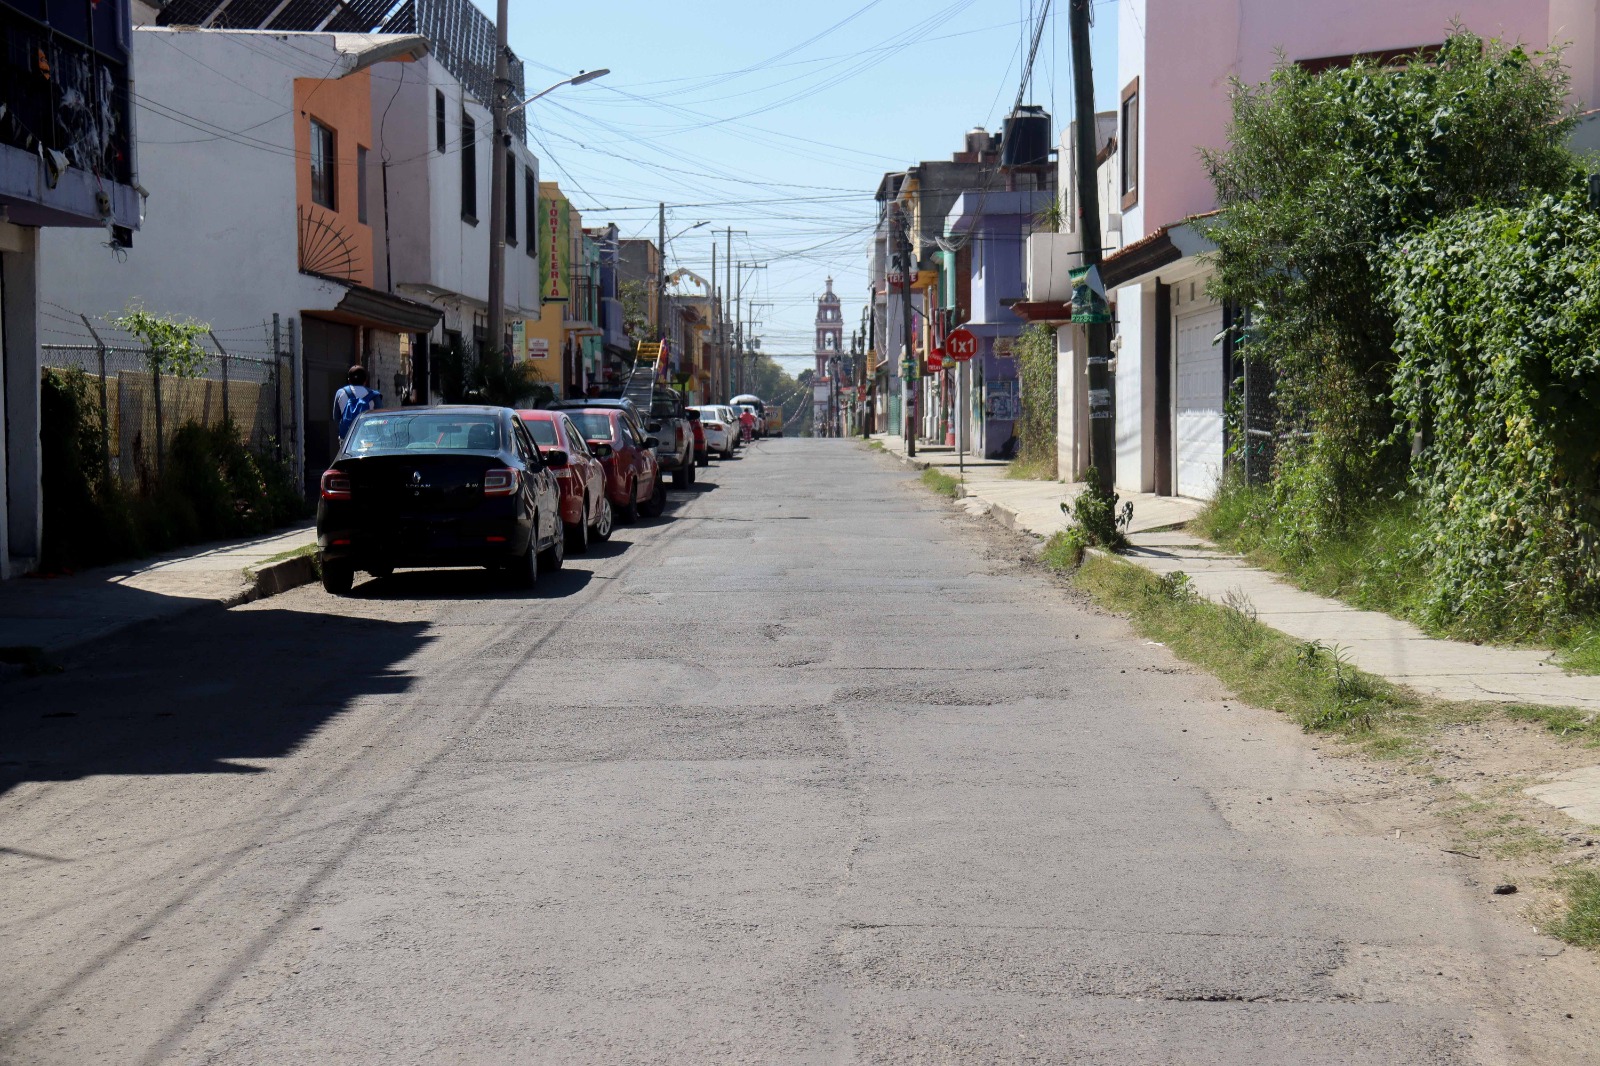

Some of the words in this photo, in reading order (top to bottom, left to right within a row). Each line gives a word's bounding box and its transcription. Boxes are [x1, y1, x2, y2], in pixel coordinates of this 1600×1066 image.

[549, 200, 559, 296] TORTILLERIA
[888, 274, 916, 283] TECE
[951, 338, 973, 352] 1x1
